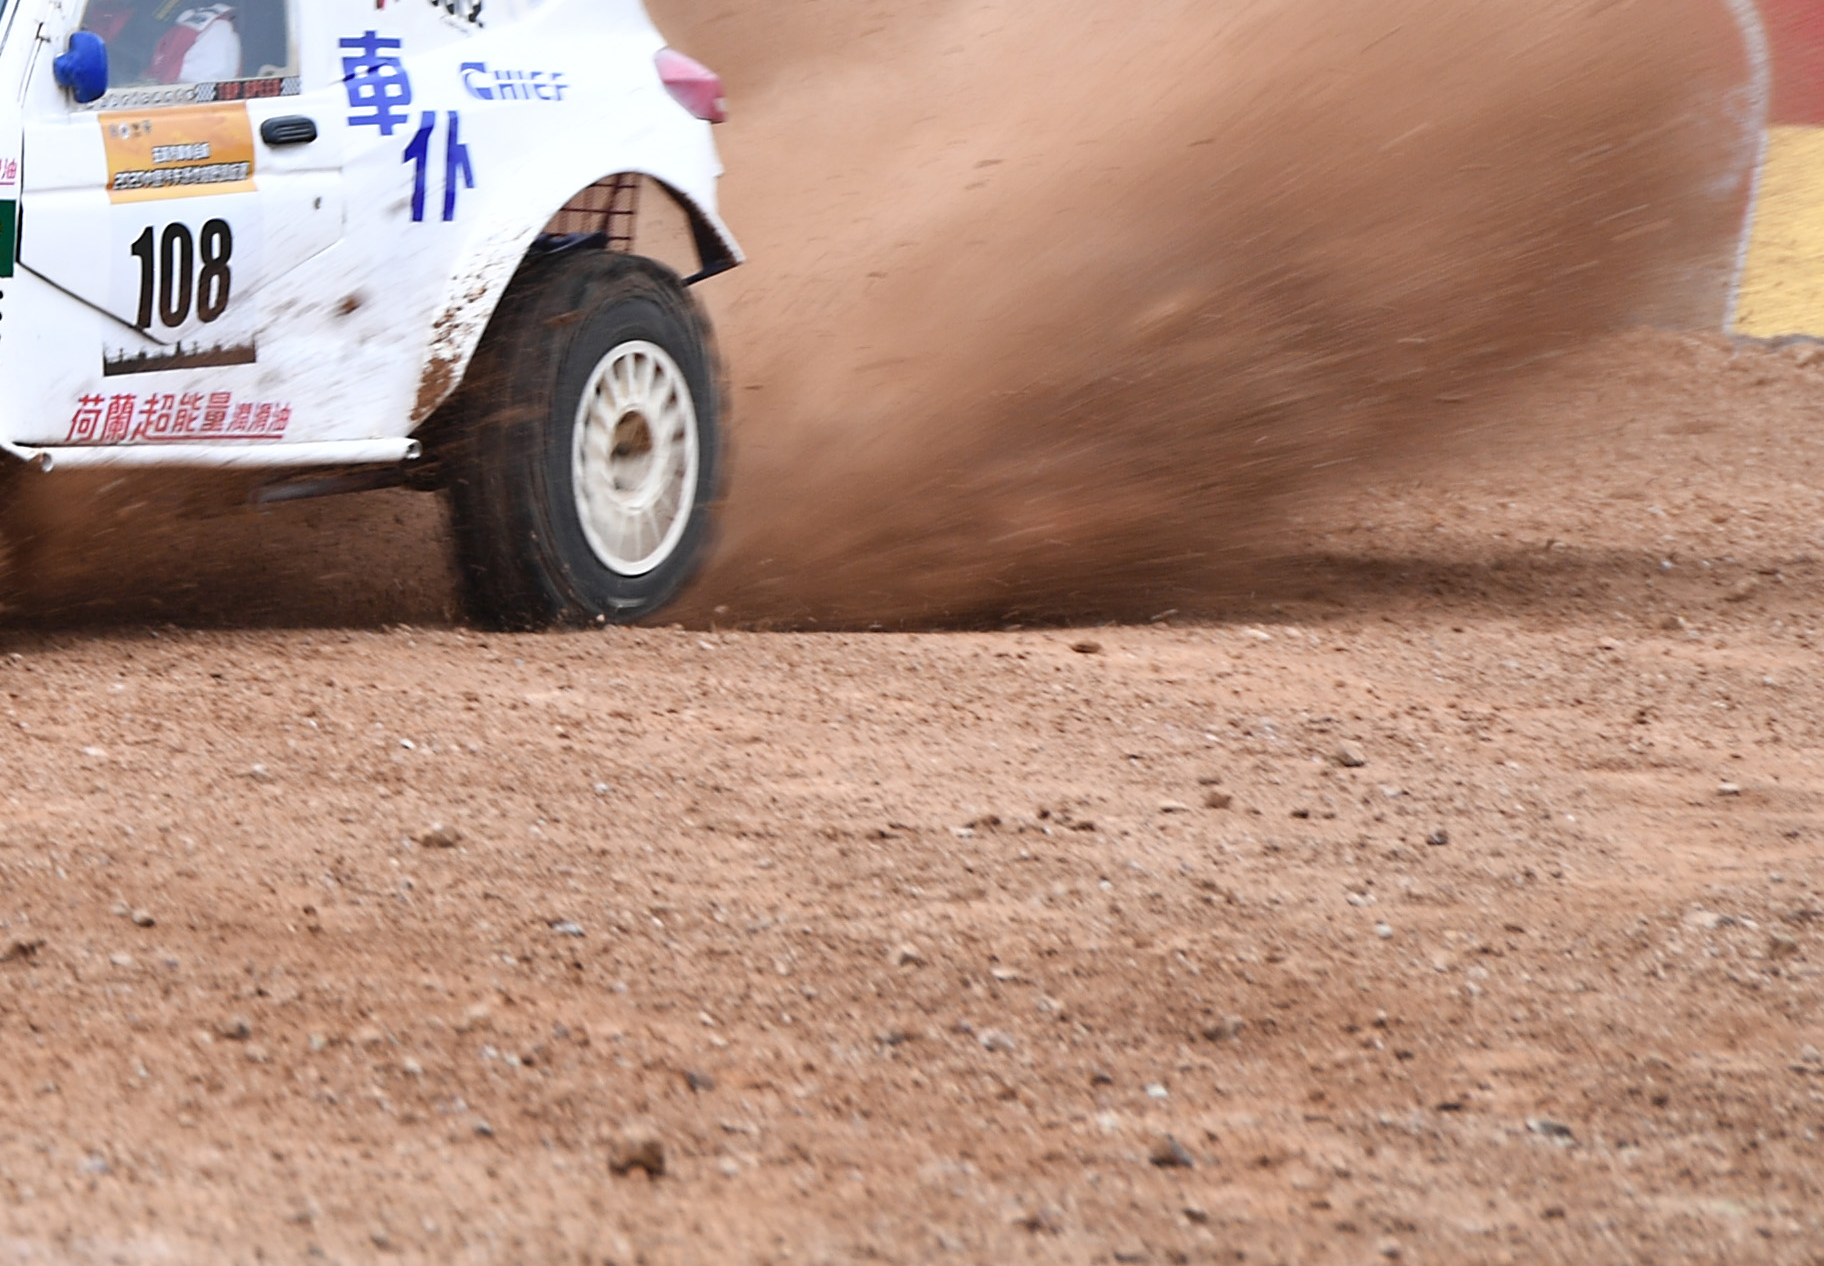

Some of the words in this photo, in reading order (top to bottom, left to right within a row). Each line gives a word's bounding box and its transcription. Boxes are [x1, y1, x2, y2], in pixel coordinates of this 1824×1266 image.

[130, 218, 233, 329] 108
[65, 391, 293, 443] 荷蘭超能量潤滑油
